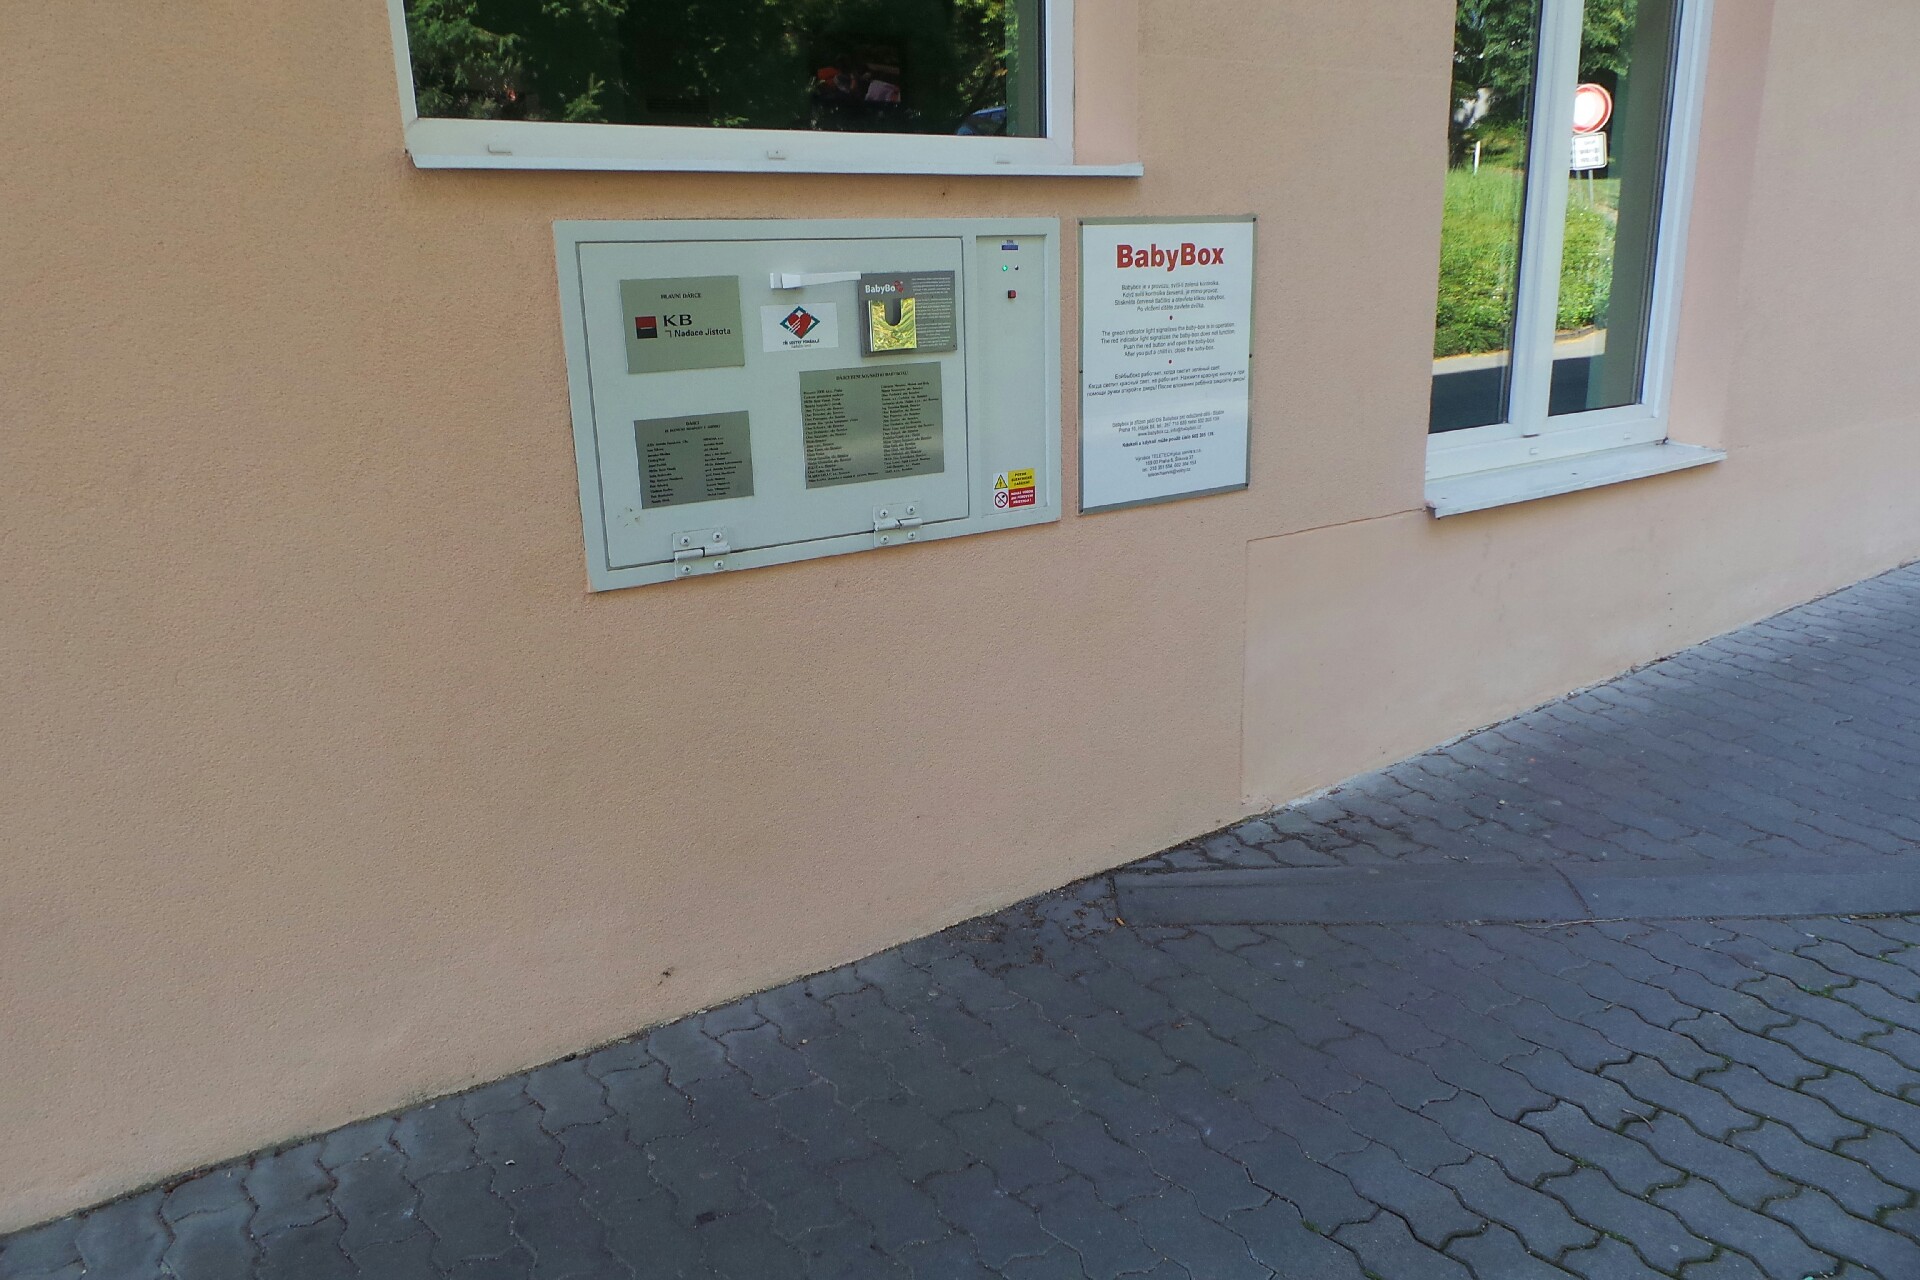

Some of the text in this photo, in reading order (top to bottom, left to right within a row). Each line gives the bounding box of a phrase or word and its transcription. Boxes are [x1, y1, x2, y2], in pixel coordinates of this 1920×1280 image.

[1116, 243, 1224, 272] BabyBox
[663, 314, 692, 327] KB
[705, 328, 731, 336] Jistota
